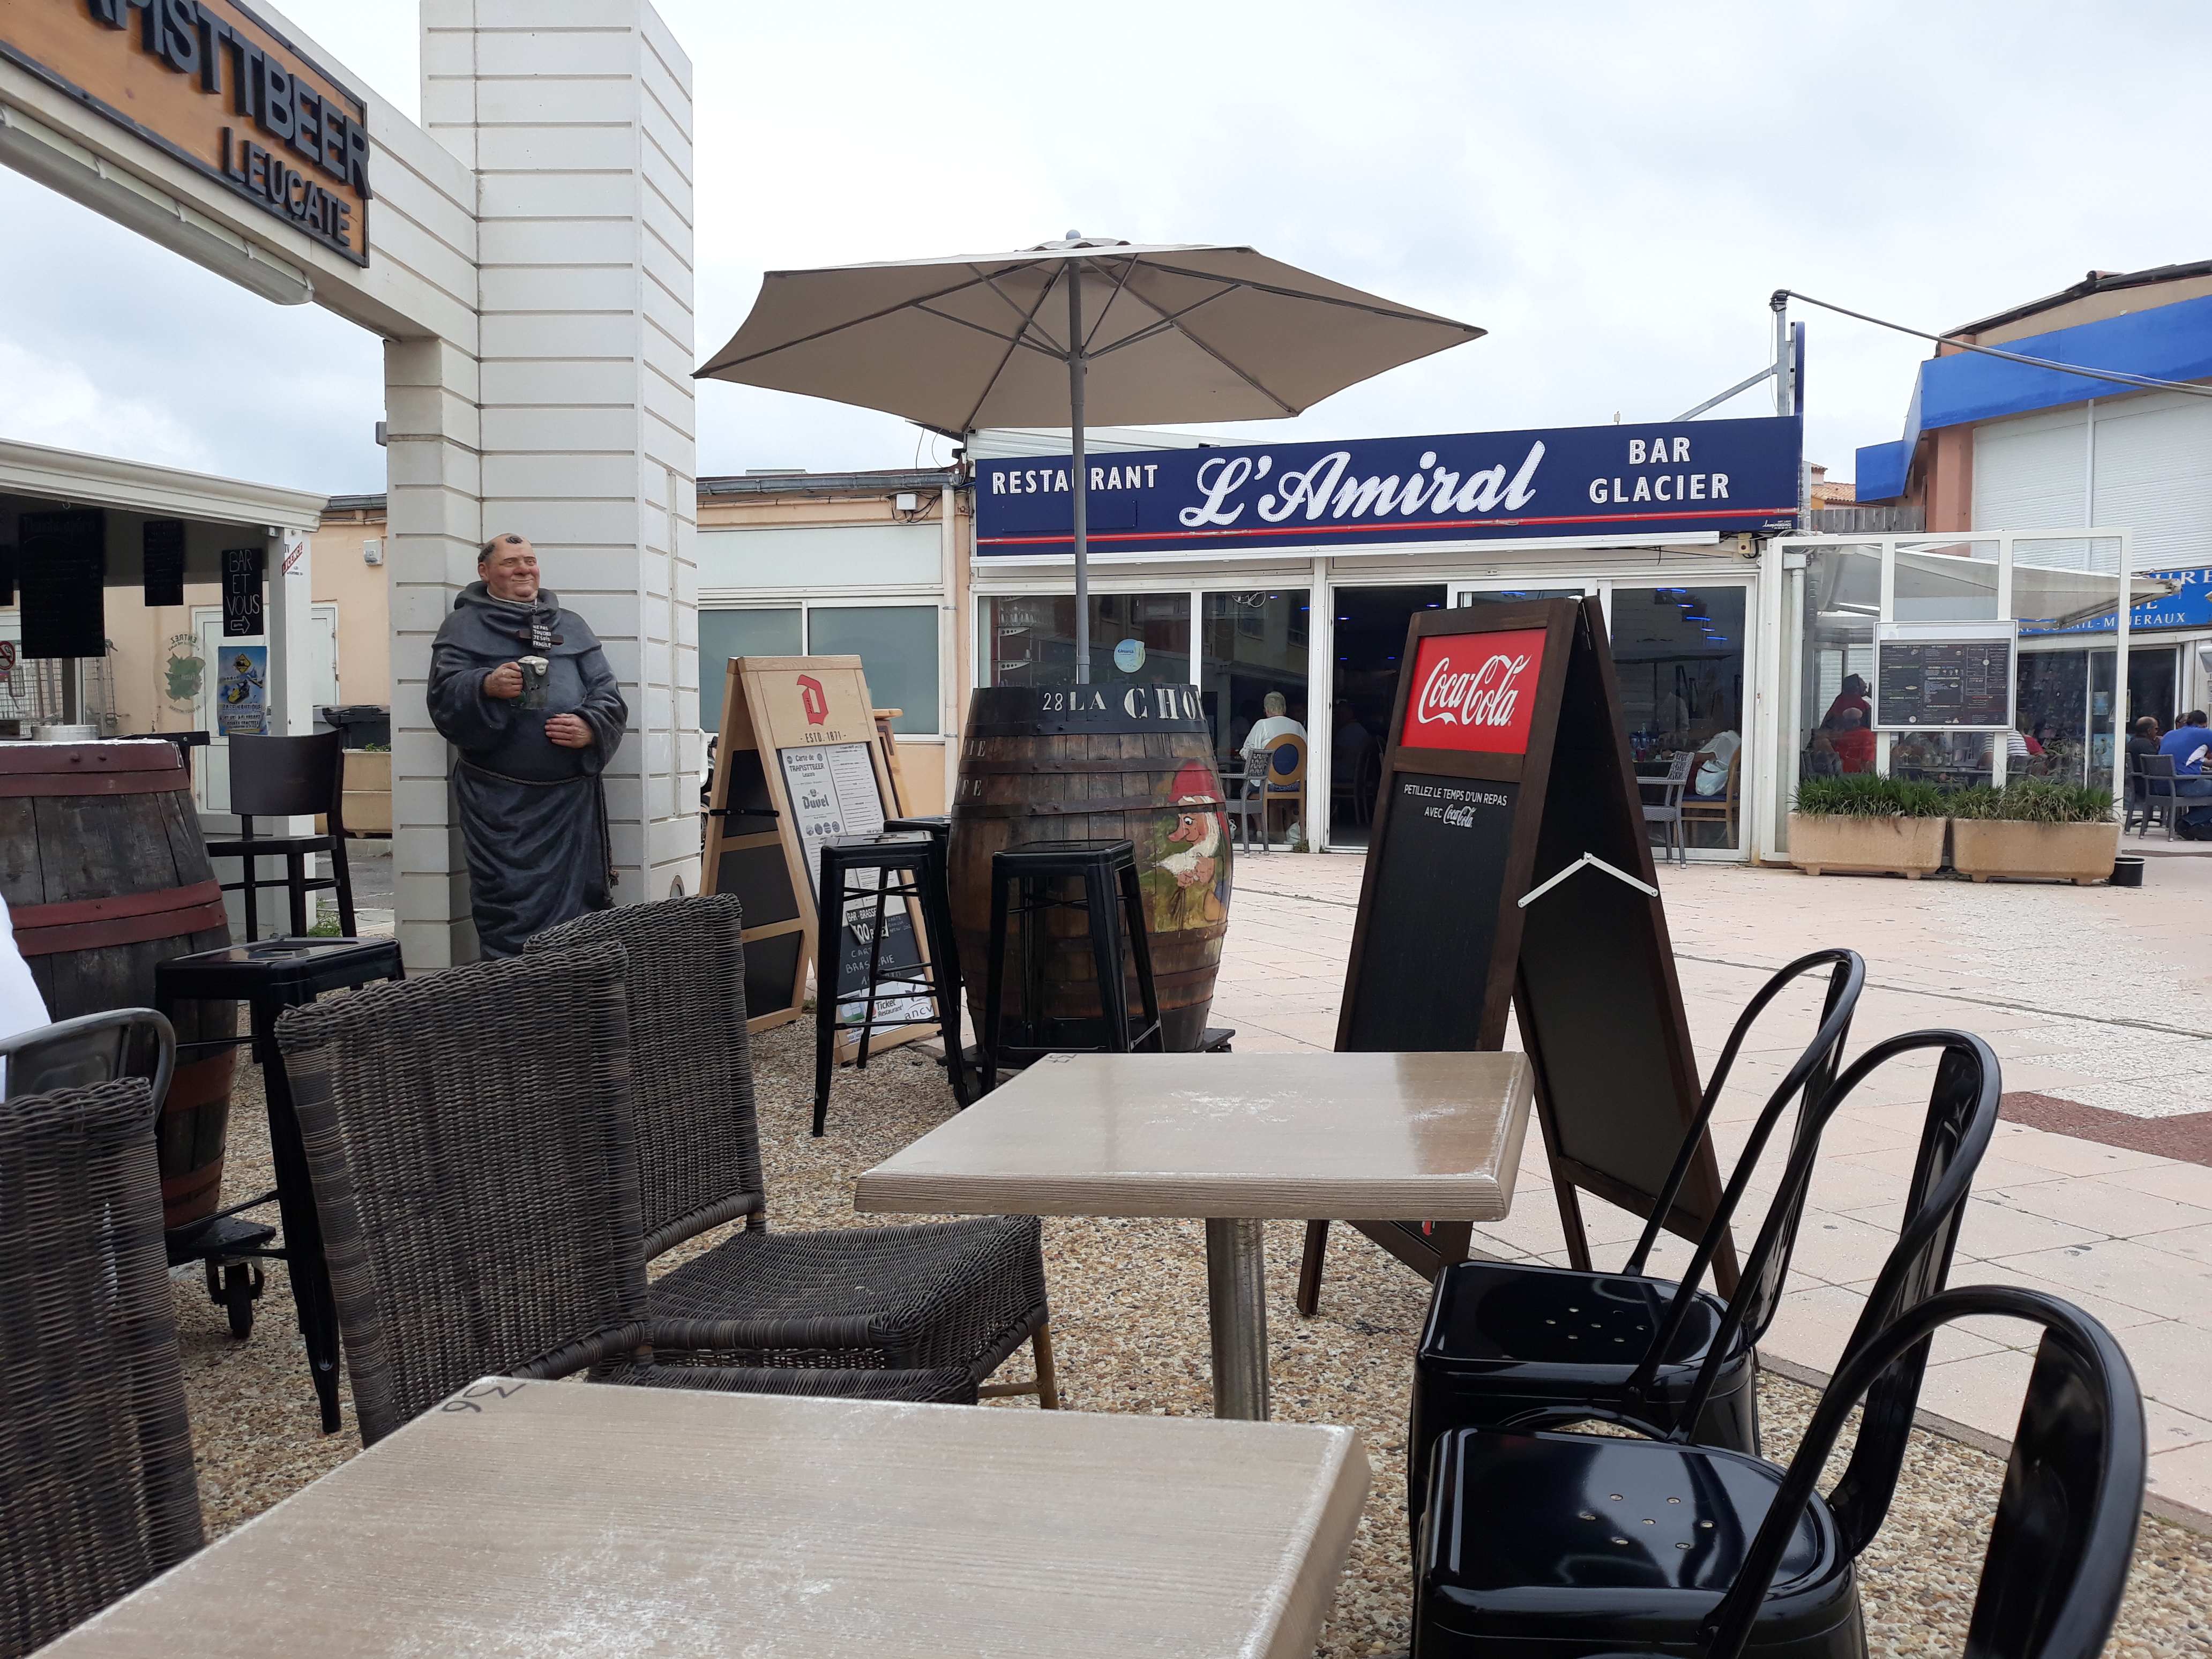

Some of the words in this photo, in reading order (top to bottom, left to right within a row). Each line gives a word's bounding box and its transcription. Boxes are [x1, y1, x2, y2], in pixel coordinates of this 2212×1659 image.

[88, 0, 372, 199] ISTTBEER
[222, 127, 351, 246] LEUCATE
[1629, 437, 1691, 465] BAR
[1179, 440, 1546, 527] L'Amiral
[1589, 473, 1730, 504] GLACIER
[229, 549, 252, 572] BAR
[282, 543, 303, 574] LICENCE
[233, 574, 250, 594] ET
[226, 594, 260, 616] VOUS
[2104, 612, 2185, 628] MERAUX
[1069, 690, 1108, 711] LA
[1417, 654, 1533, 727] Coca-Cola
[1042, 692, 1064, 712] 28
[826, 731, 842, 742] 1871
[789, 763, 825, 772] TRAPISTTBEER
[802, 794, 829, 809] Duvel
[1403, 784, 1433, 797] PETILLEZ
[1433, 788, 1443, 798] LE
[1443, 788, 1464, 802] TEMPS
[1465, 791, 1482, 803] D'UN
[1483, 793, 1508, 806] REPAS
[1424, 806, 1443, 818] AVEC
[1443, 803, 1477, 828] Coca-Cola
[846, 954, 895, 974] BRASRIE
[876, 999, 896, 1011] Ticket
[878, 1005, 903, 1018] Restaurant
[904, 1005, 932, 1020] ancv
